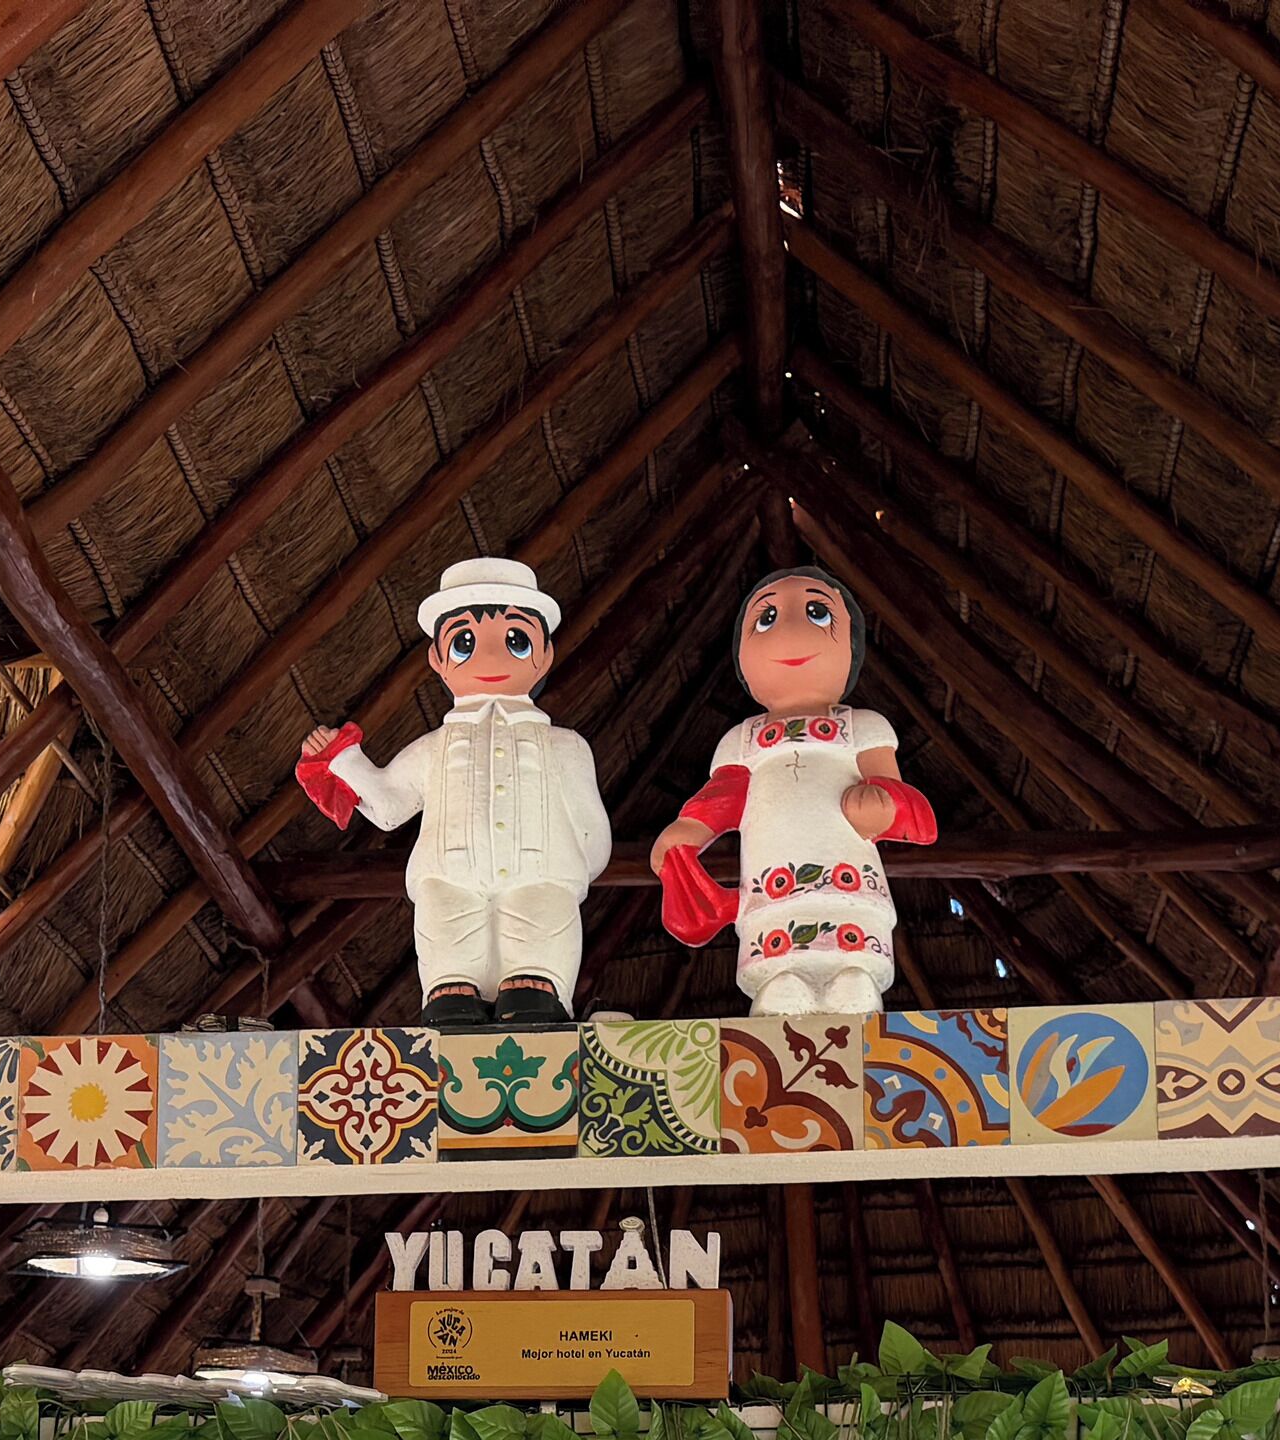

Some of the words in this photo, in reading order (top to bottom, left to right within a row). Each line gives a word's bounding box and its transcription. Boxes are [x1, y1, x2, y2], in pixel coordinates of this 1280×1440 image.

[559, 1330, 612, 1341] HAMEKI
[521, 1349, 553, 1360] Mejor
[556, 1349, 584, 1358] hotel
[588, 1350, 602, 1359] en
[605, 1348, 651, 1358] Yucatán
